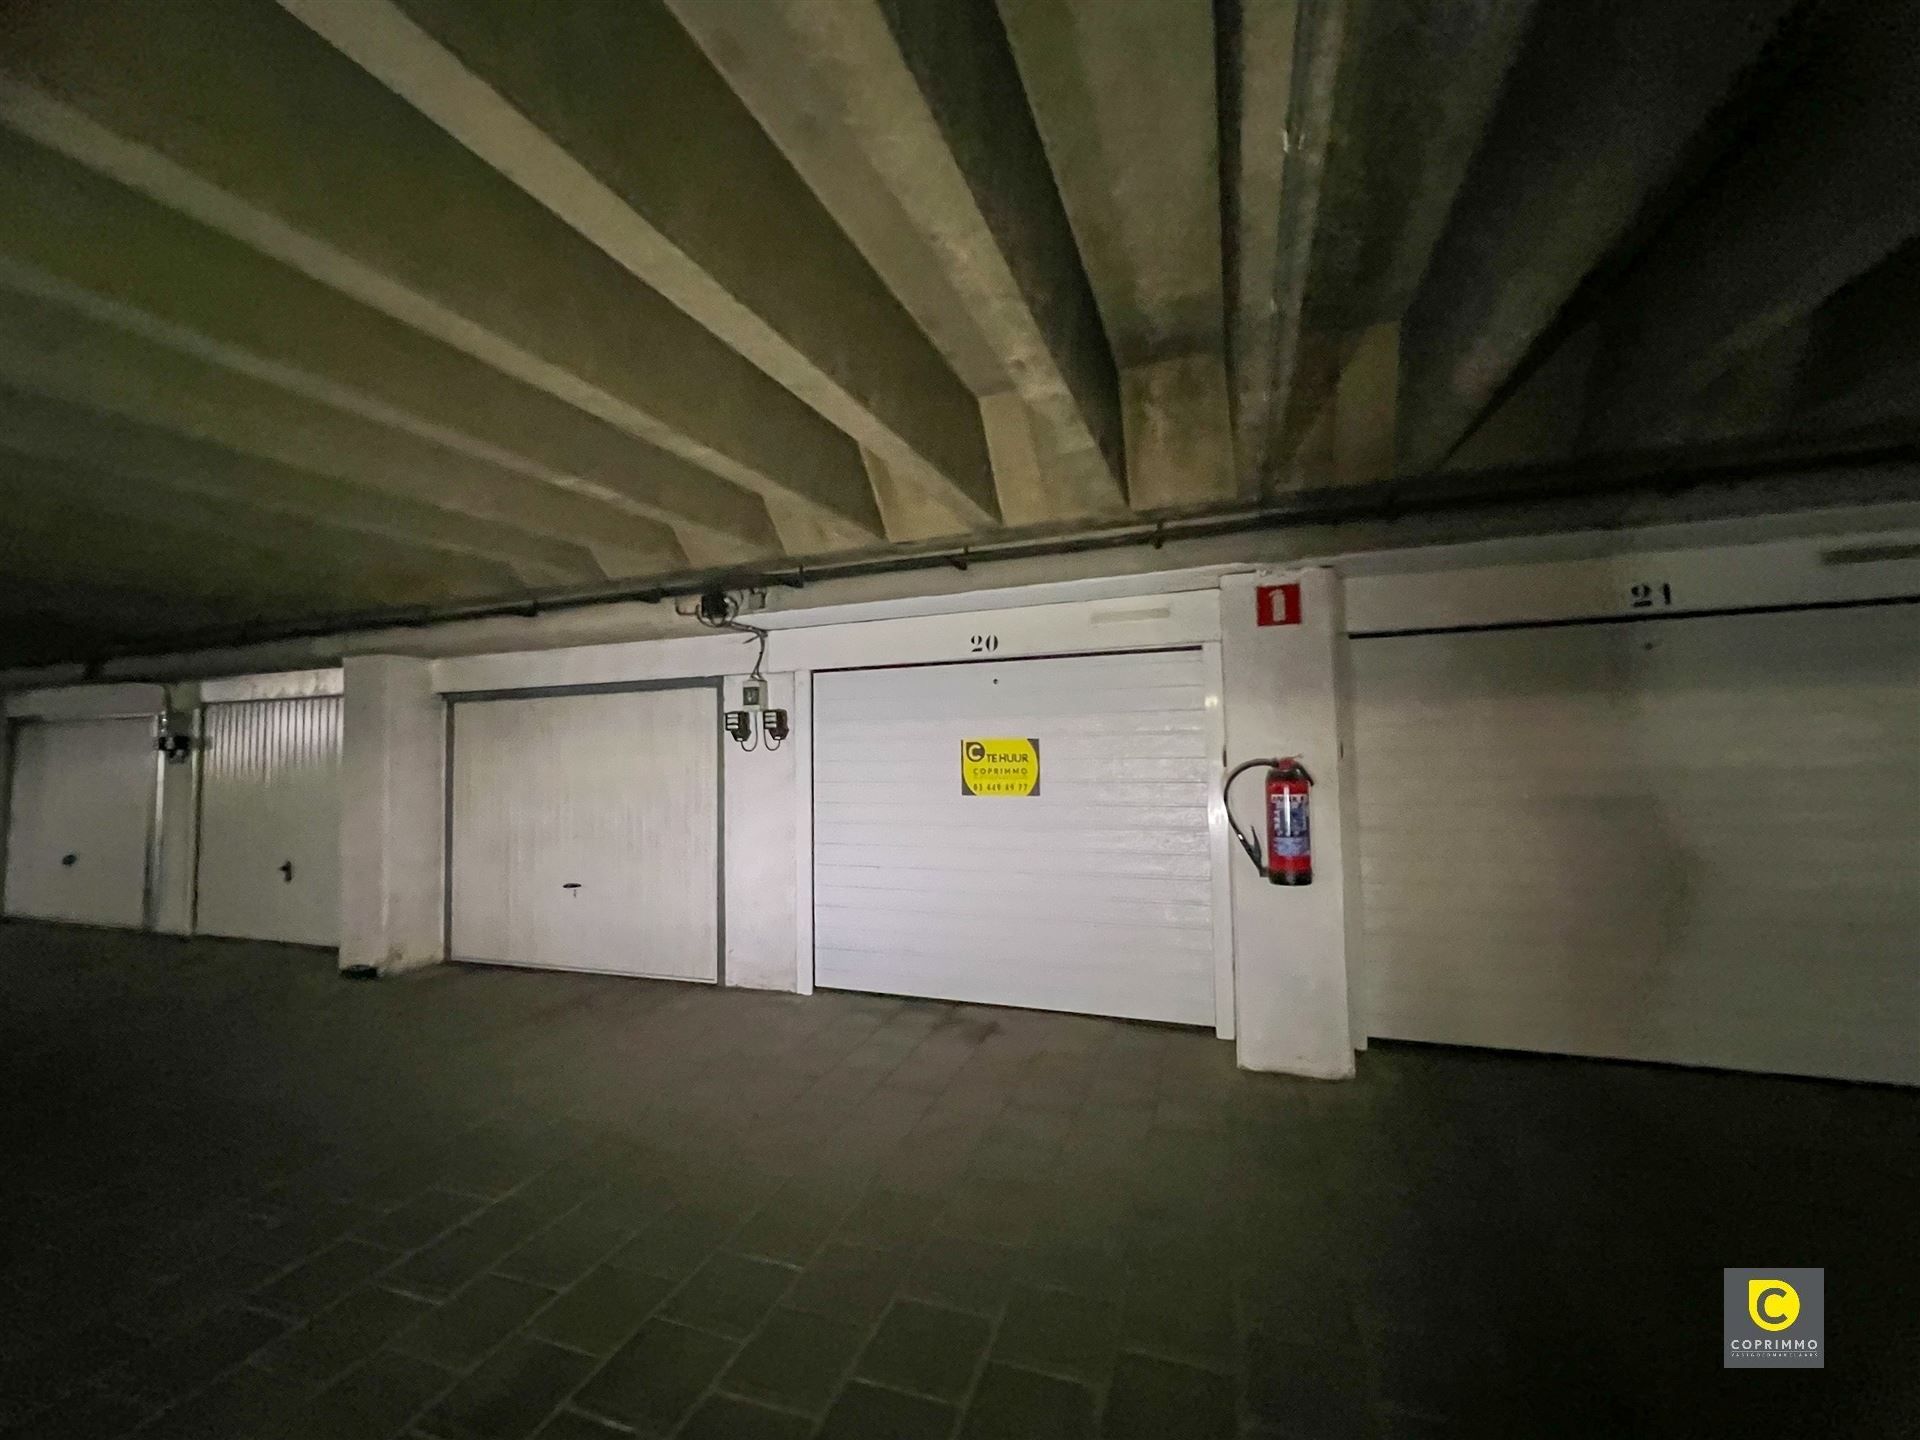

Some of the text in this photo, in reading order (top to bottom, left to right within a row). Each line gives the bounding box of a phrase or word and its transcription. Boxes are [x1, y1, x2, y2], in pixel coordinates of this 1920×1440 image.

[1630, 582, 1672, 607] 21
[1268, 588, 1287, 622] 1
[970, 634, 999, 652] 20
[986, 753, 1029, 763] TE HUUR
[973, 767, 1028, 775] COPRIMMO
